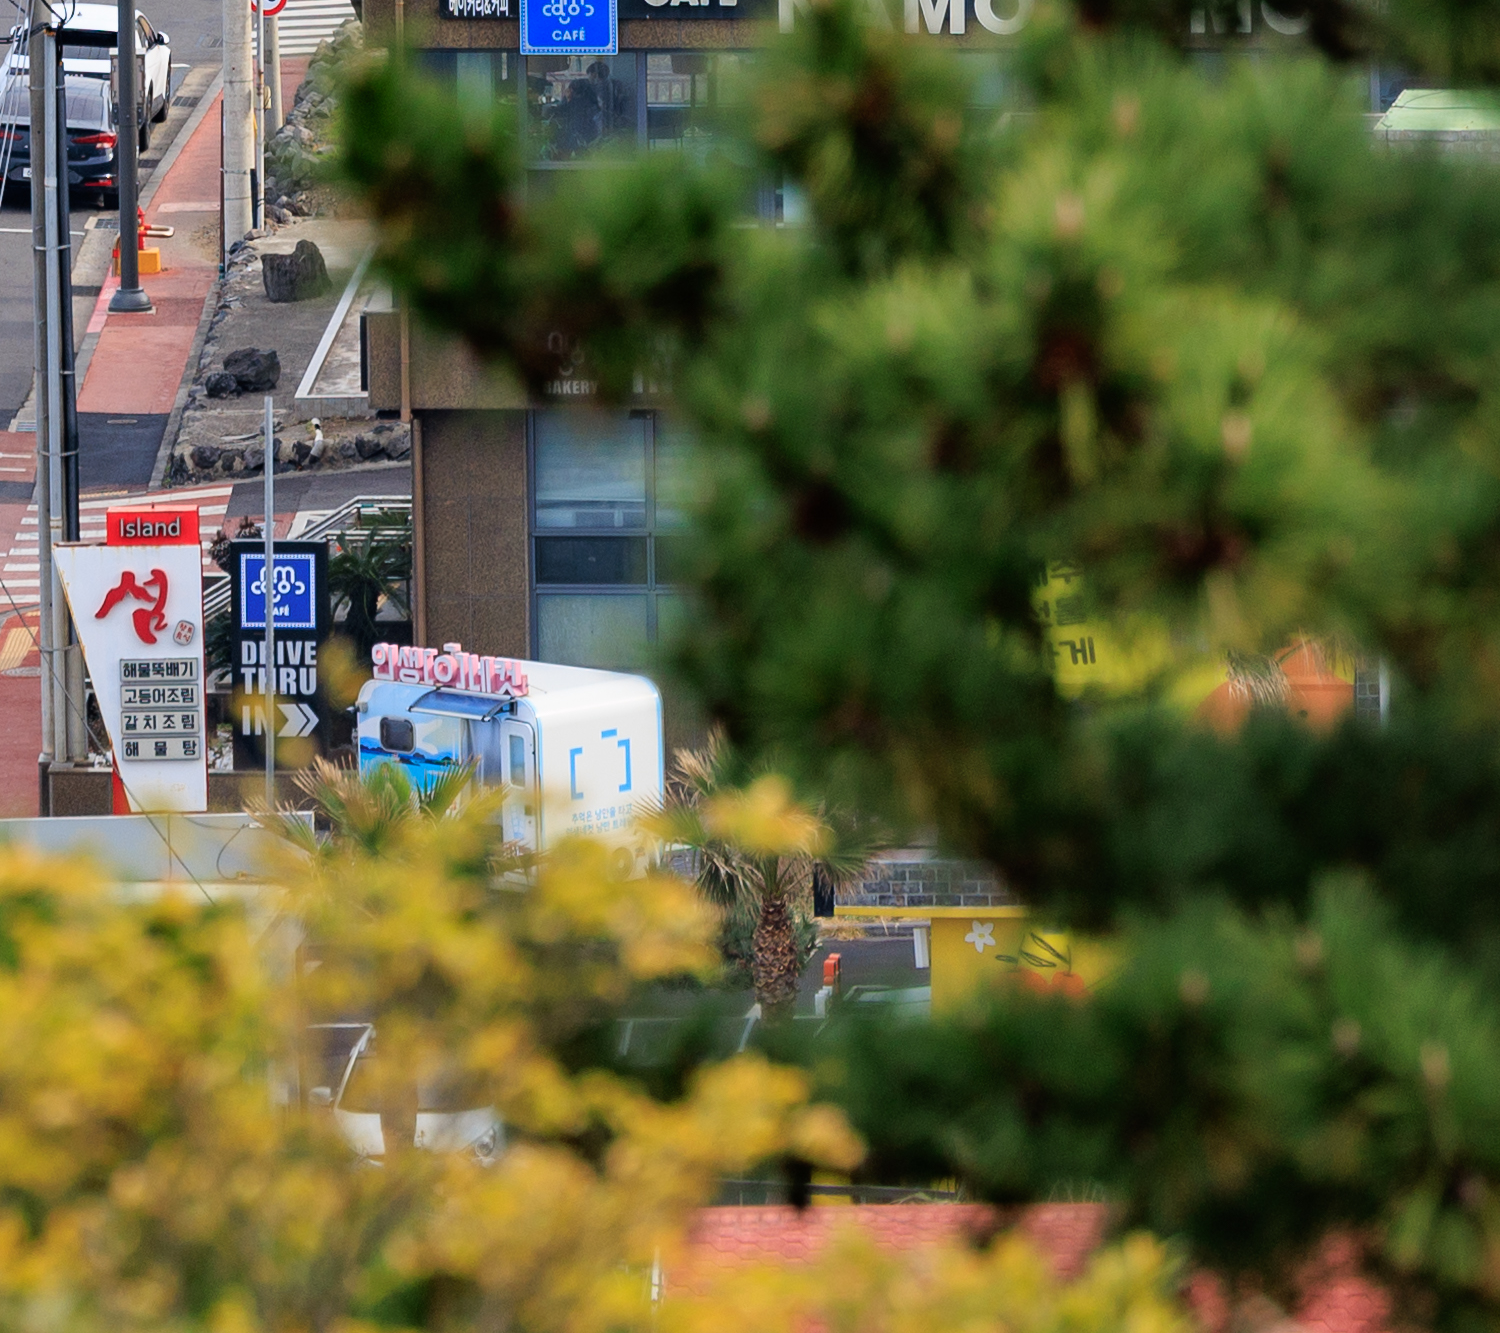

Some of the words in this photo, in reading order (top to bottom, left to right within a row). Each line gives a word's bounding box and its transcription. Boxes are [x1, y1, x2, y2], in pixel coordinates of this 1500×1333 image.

[552, 26, 586, 41] CAFÉ
[119, 517, 181, 537] Island
[95, 569, 168, 644] 섬
[264, 603, 290, 617] AFÉ
[122, 661, 194, 678] 해물뚝배기
[240, 667, 317, 695] THRU
[123, 687, 195, 704] 고등어조림
[124, 714, 195, 731] 갈치조림
[242, 705, 270, 736] IN
[125, 740, 197, 757] 해물탕
